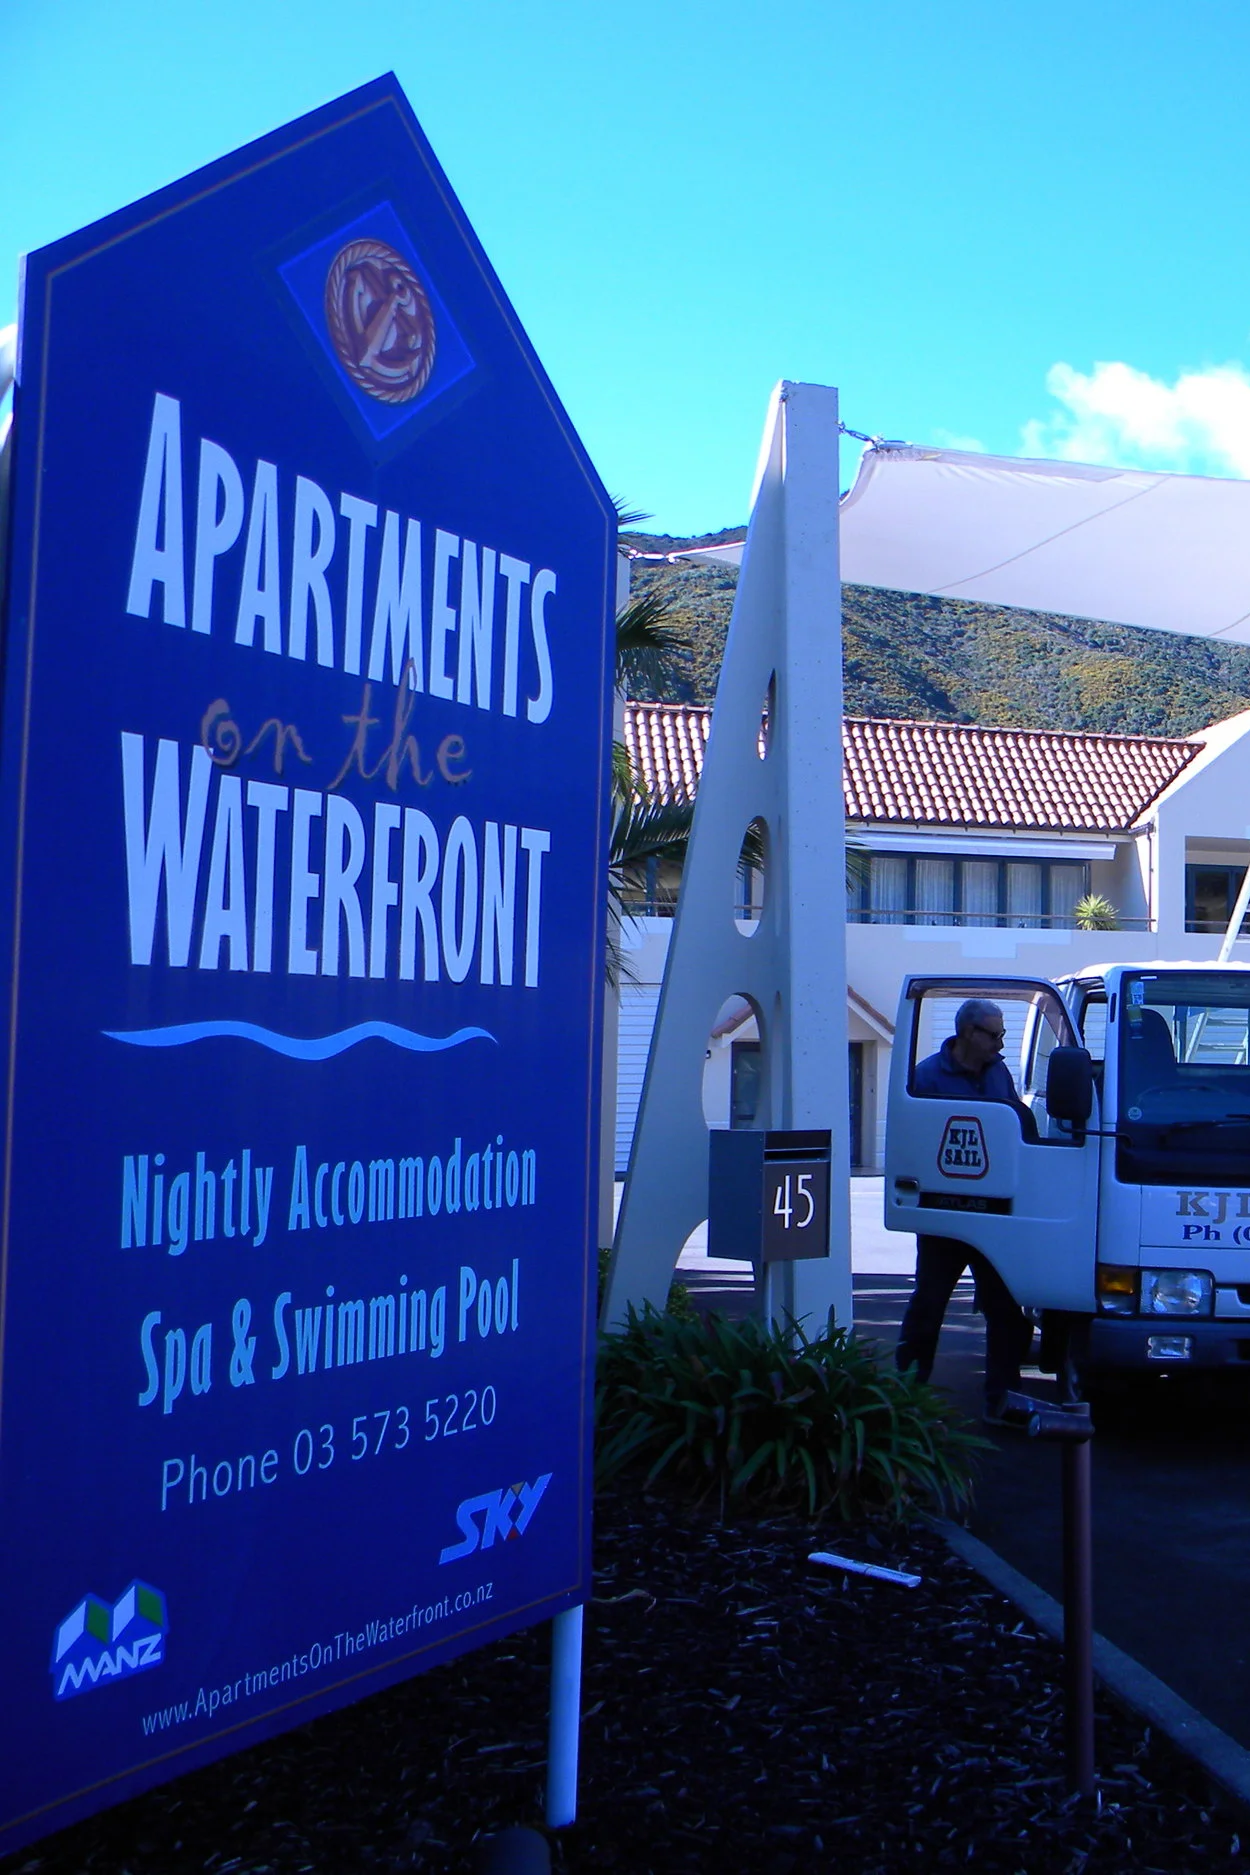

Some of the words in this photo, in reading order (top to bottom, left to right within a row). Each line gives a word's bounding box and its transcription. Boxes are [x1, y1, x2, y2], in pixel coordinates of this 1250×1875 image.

[126, 392, 557, 724] APARTMENTS
[201, 698, 312, 774] on
[327, 656, 472, 791] the
[121, 731, 551, 988] WATERFRONT
[121, 1149, 274, 1256] Nightly
[288, 1134, 537, 1231] Accommodation
[944, 1149, 981, 1167] SAIL
[949, 1128, 978, 1147] KJL
[773, 1174, 815, 1230] 45
[1182, 1224, 1222, 1242] Ph
[138, 1310, 212, 1414] Spa
[229, 1298, 257, 1388] &
[272, 1275, 447, 1379] Swimming
[458, 1258, 520, 1342] Pool
[161, 1449, 279, 1511] Phone
[293, 1423, 335, 1476] 03
[351, 1405, 410, 1461] 573
[424, 1385, 497, 1442] 5220
[438, 1472, 553, 1565] SKY
[57, 1633, 163, 1696] MANZ
[141, 1581, 494, 1736] www.ApartmentsOnTheWaterfront.co.nz
